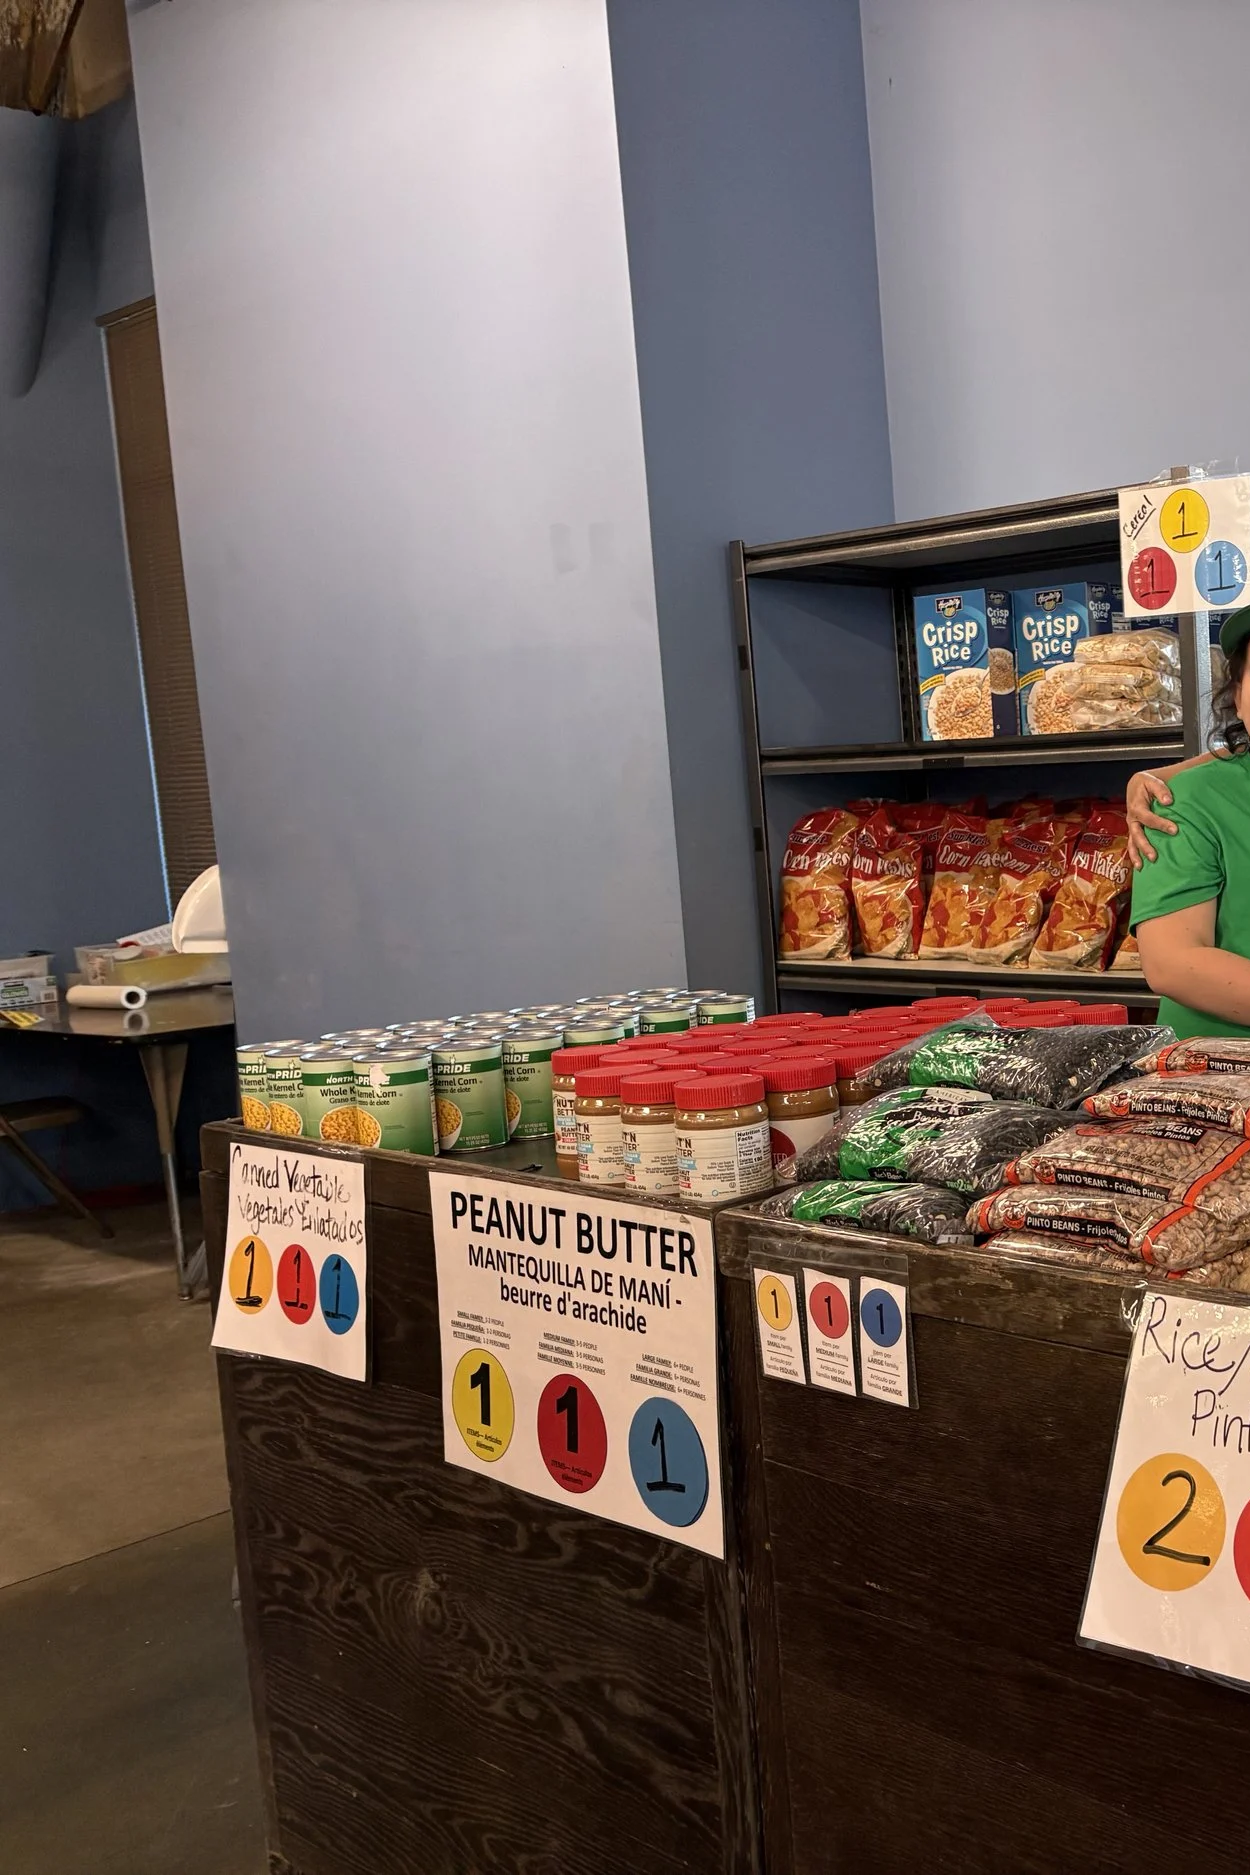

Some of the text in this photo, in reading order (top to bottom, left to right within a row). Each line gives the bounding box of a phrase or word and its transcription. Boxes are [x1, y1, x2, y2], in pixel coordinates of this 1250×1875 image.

[1172, 502, 1198, 539] 1
[1140, 550, 1236, 597] 1 1
[987, 607, 1010, 618] Crisp
[1088, 600, 1110, 611] Crisp
[1092, 609, 1108, 620] Rice
[991, 617, 1007, 626] Rice
[1022, 615, 1079, 640] Crisp
[923, 621, 977, 647] Crisp
[931, 643, 971, 667] Rice
[1031, 638, 1072, 662] Rice
[437, 1063, 471, 1075] PRIDE
[503, 1053, 530, 1063] RIDE
[276, 1070, 301, 1080] PRID
[458, 1076, 477, 1086] Corn
[516, 1066, 535, 1075] Corn
[320, 1087, 348, 1097] Whole
[557, 1108, 574, 1117] BETT
[1131, 1102, 1154, 1113] PINTO
[1154, 1103, 1176, 1113] BEANS
[1164, 1131, 1191, 1141] Pintos
[1165, 1124, 1204, 1137] BEANS
[1057, 1172, 1083, 1184] PINTO
[450, 1191, 698, 1277] PEANUT BUTTER
[1026, 1216, 1050, 1228] PINTO
[1052, 1219, 1080, 1233] BEANS
[236, 1241, 351, 1320] 1 1 1
[468, 1244, 586, 1290] MANTEQUILLA
[591, 1269, 613, 1297] DE
[619, 1275, 671, 1309] MANÍ
[500, 1277, 647, 1334] beurre d'arachide
[771, 1289, 779, 1319] 1
[824, 1296, 833, 1327] 1
[876, 1303, 885, 1335] 1
[470, 1362, 491, 1427] 1
[556, 1385, 578, 1453] 1
[647, 1418, 686, 1492] 1
[1142, 1469, 1211, 1567] 2
